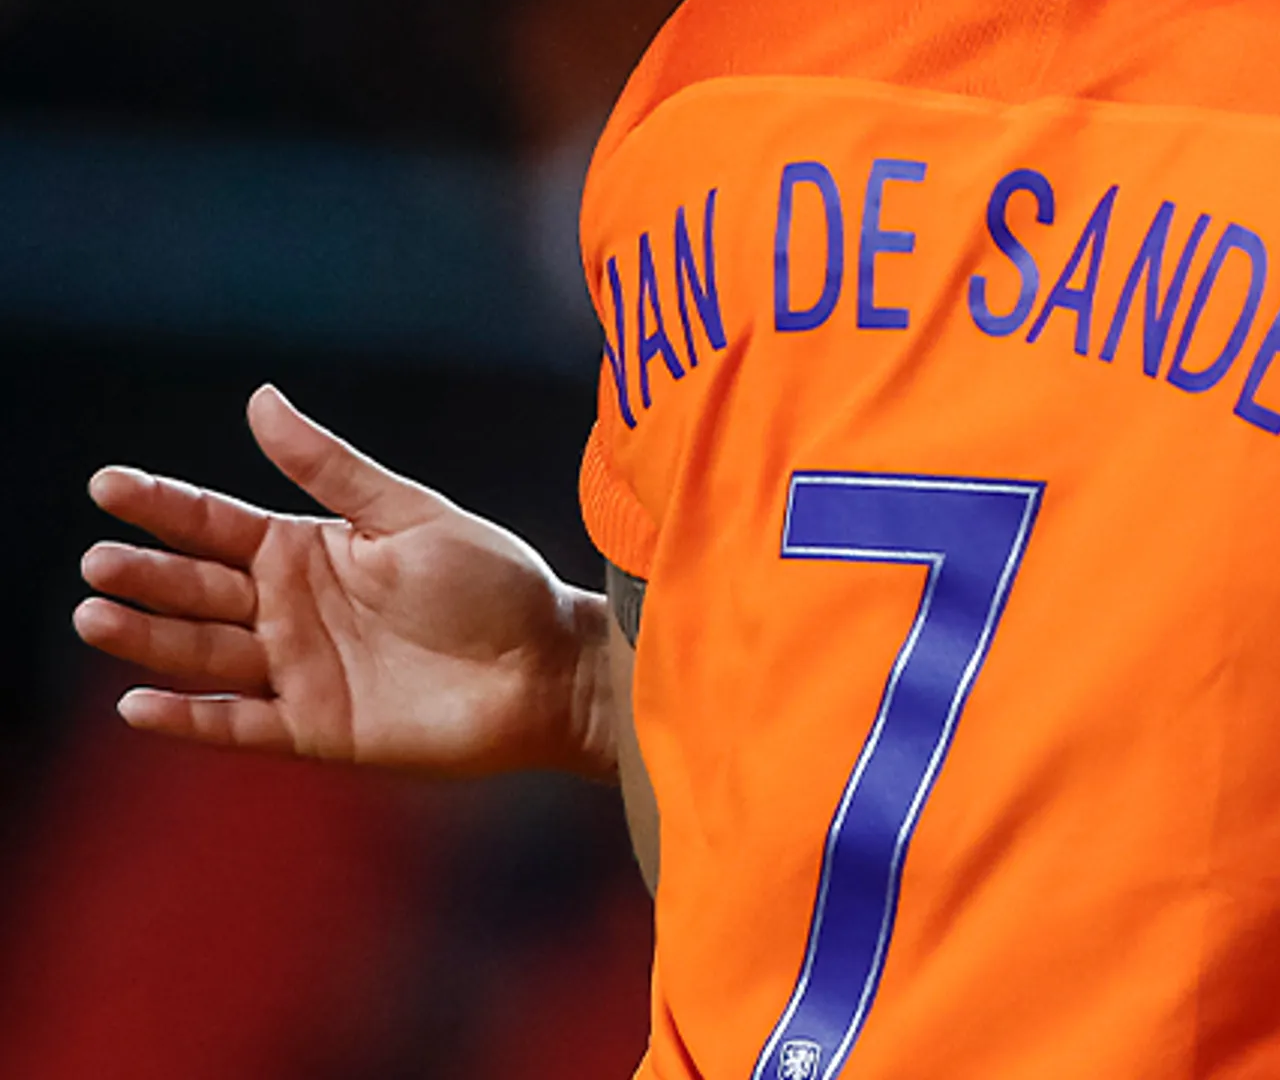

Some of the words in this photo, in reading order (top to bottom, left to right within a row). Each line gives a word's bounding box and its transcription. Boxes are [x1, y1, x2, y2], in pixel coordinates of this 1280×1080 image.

[604, 188, 727, 429] VAN
[773, 159, 928, 332] DE
[750, 470, 1048, 1080] 7
